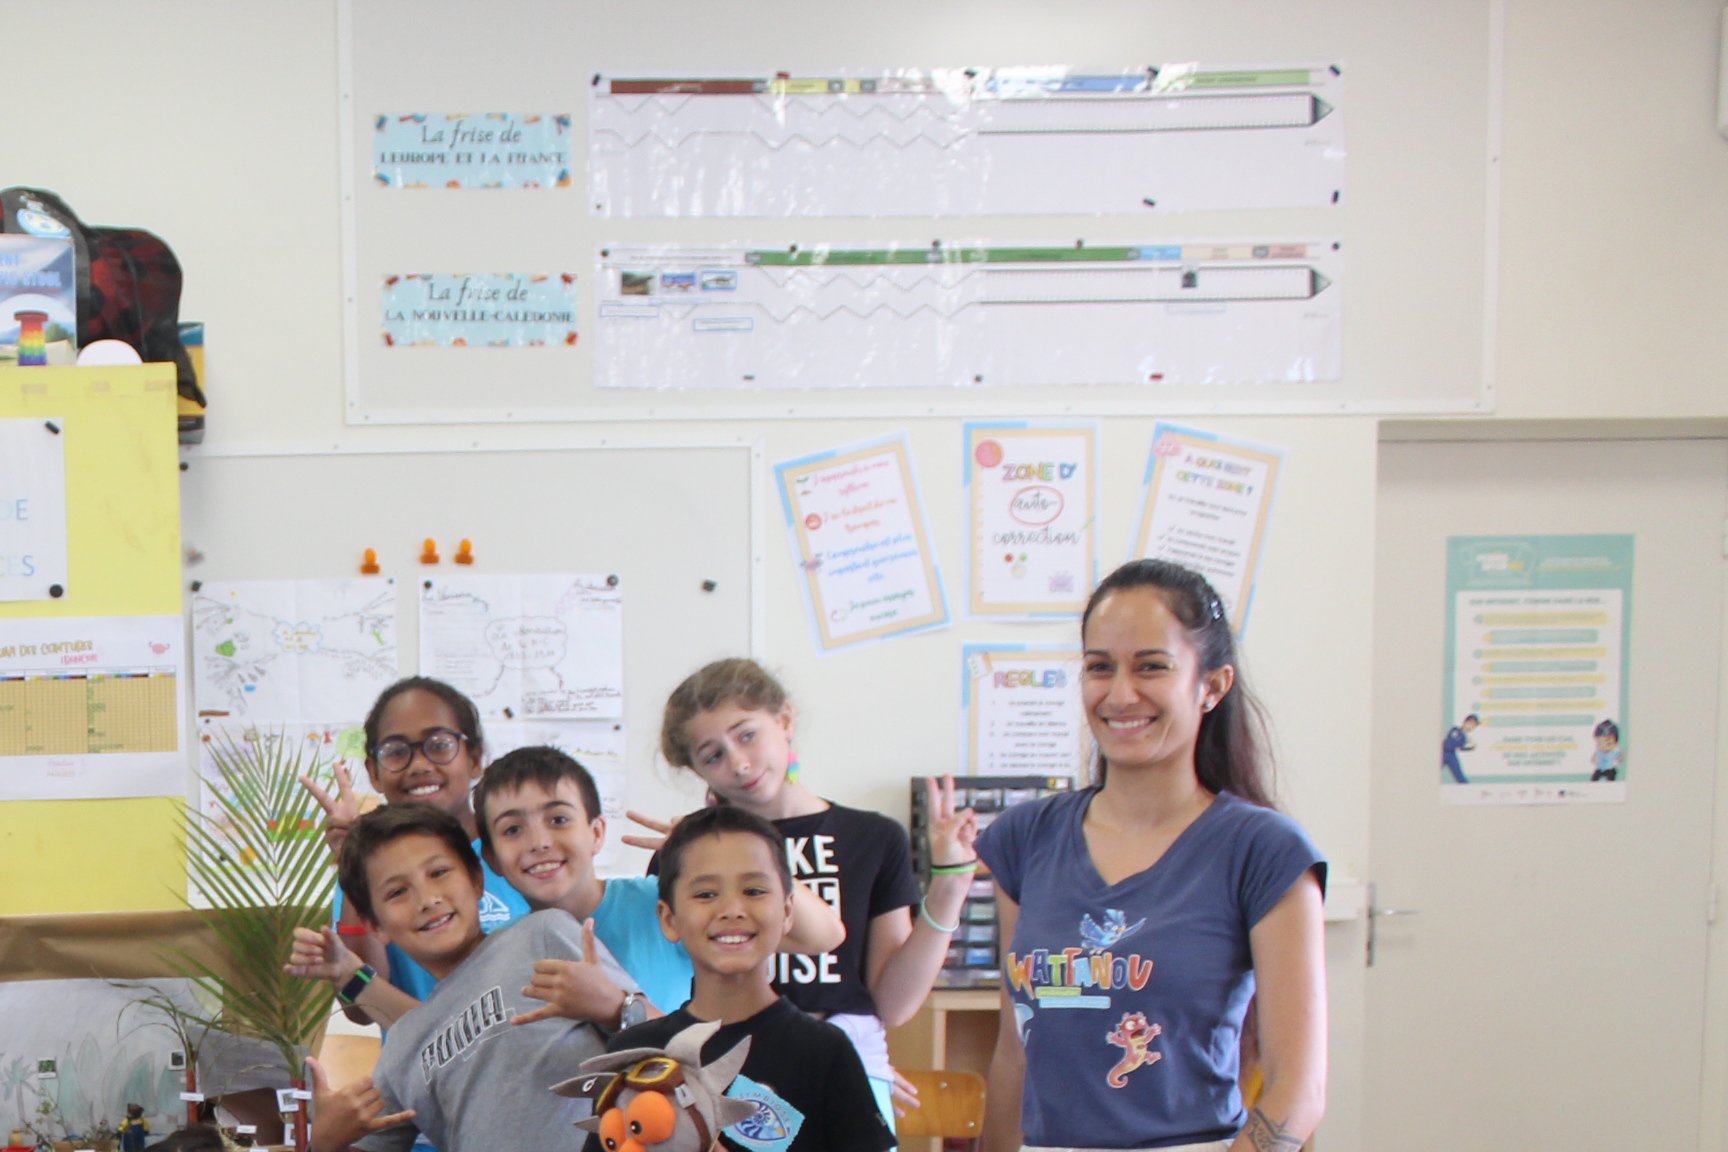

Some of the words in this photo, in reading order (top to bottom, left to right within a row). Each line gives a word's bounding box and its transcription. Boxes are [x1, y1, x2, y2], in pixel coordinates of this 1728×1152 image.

[422, 125, 443, 143] La
[449, 119, 492, 149] frise
[499, 120, 522, 143] de
[428, 282, 451, 300] La
[456, 277, 499, 307] frise
[506, 279, 528, 300] de
[1002, 462, 1054, 482] ZONE
[994, 524, 1079, 546] correction
[768, 951, 842, 984] ISE
[1007, 947, 1154, 1000] WATTANOU
[421, 986, 507, 1085] PUMA
